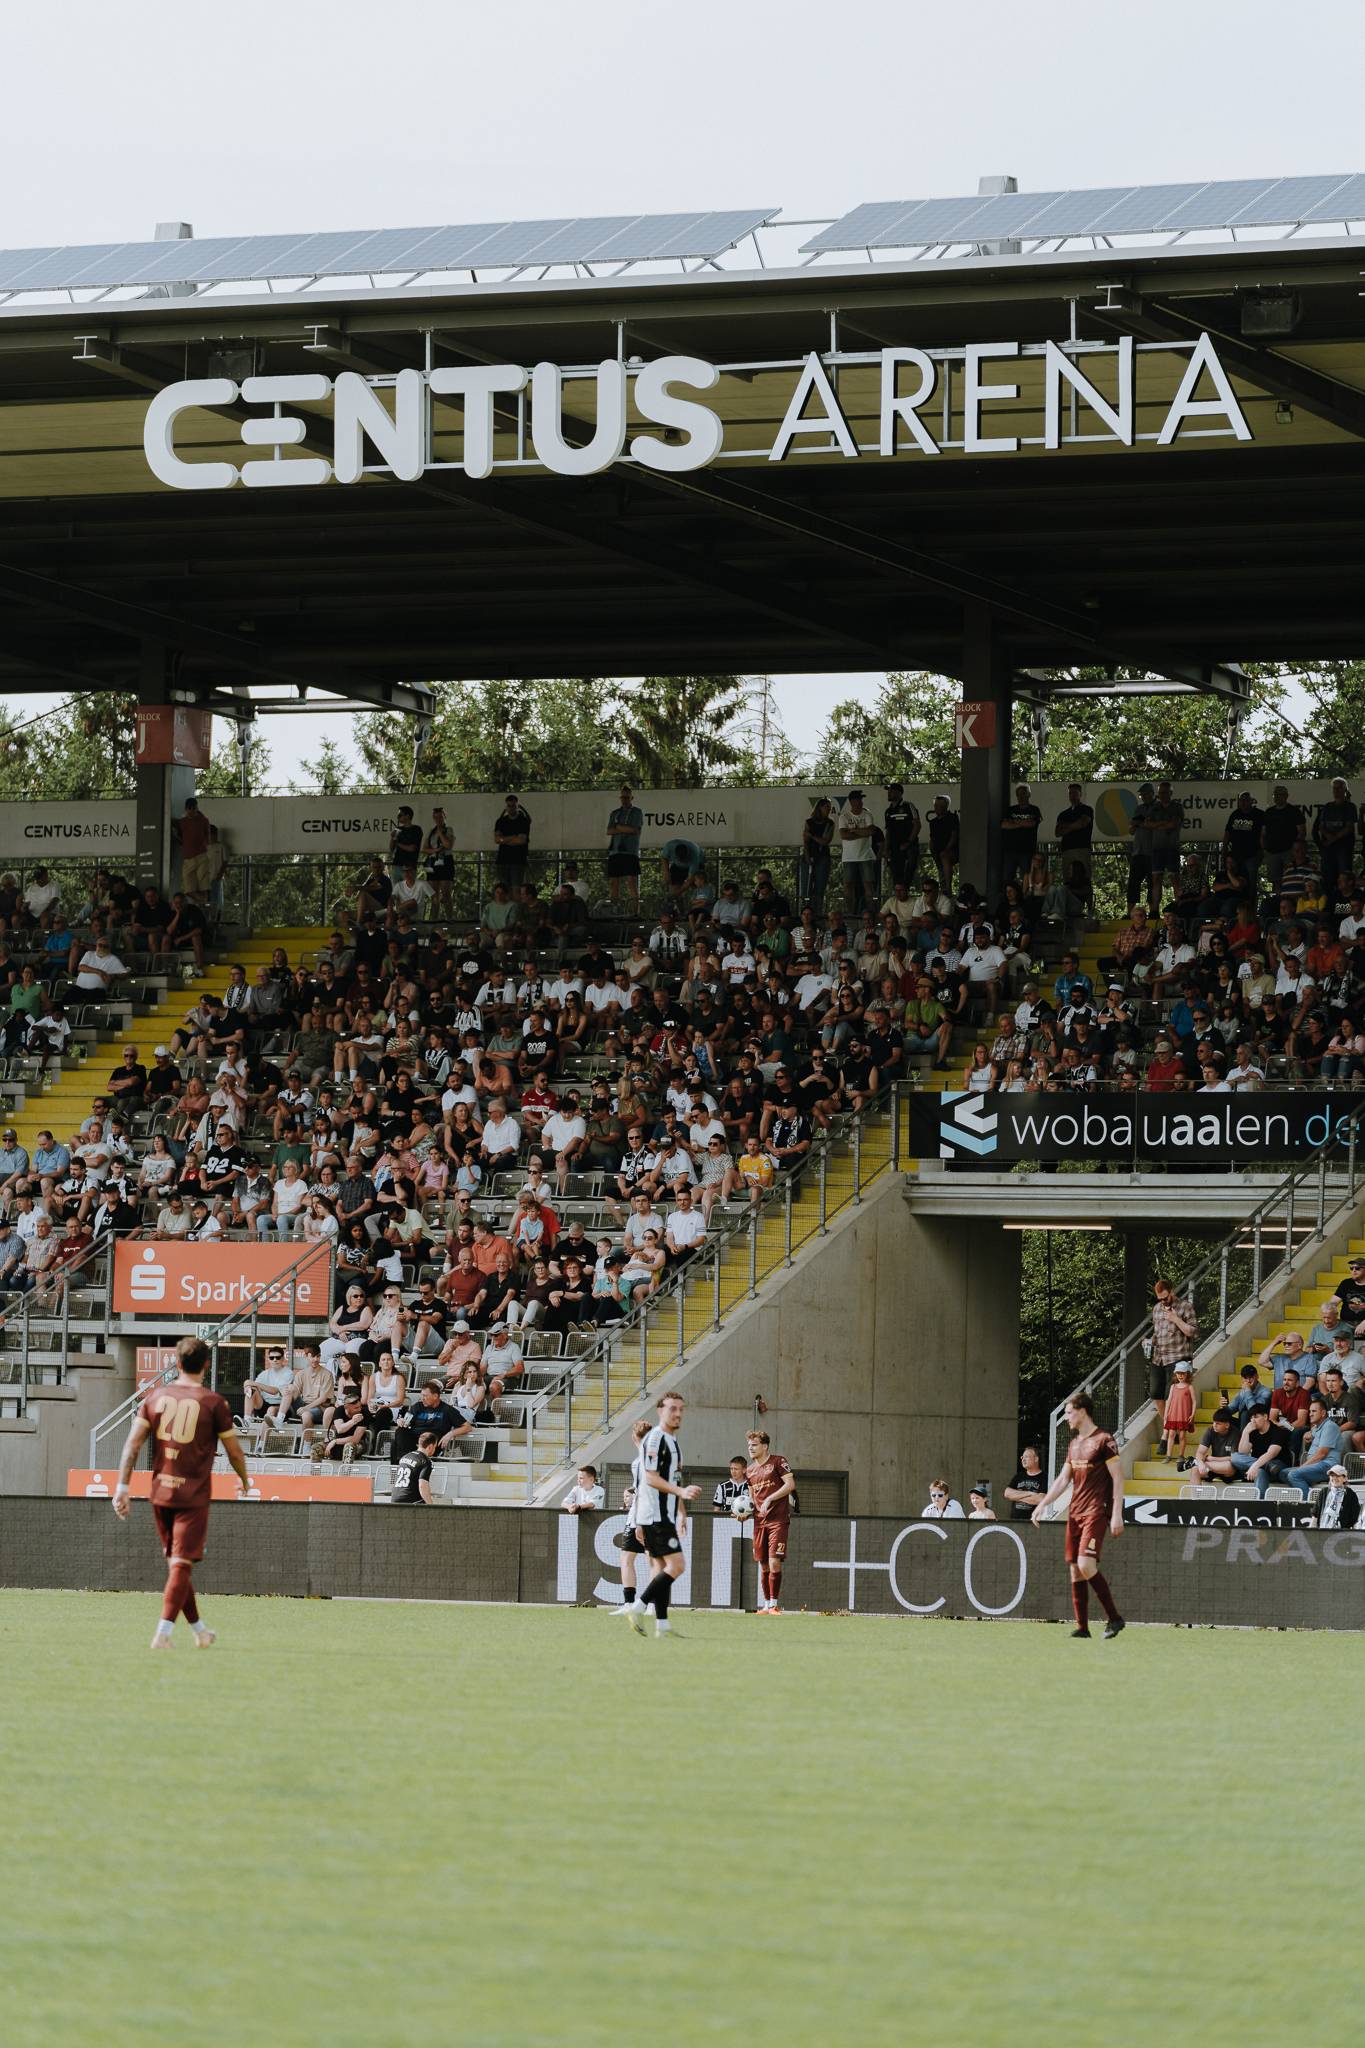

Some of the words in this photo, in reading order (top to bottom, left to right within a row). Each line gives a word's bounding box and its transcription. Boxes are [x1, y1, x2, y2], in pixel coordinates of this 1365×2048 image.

[144, 356, 724, 489] CENTUS
[768, 331, 1253, 461] ARENA
[138, 713, 161, 721] BLOCK
[956, 704, 981, 712] BLOCK
[138, 723, 146, 754] J
[956, 715, 978, 747] K
[302, 818, 401, 833] CENTUSAREN
[645, 812, 728, 826] TUSARENA
[24, 824, 130, 838] CENTUSARENA
[206, 1156, 230, 1174] 92
[180, 1275, 312, 1307] Sparkasse
[155, 1396, 201, 1444] 20
[395, 1467, 411, 1488] 23
